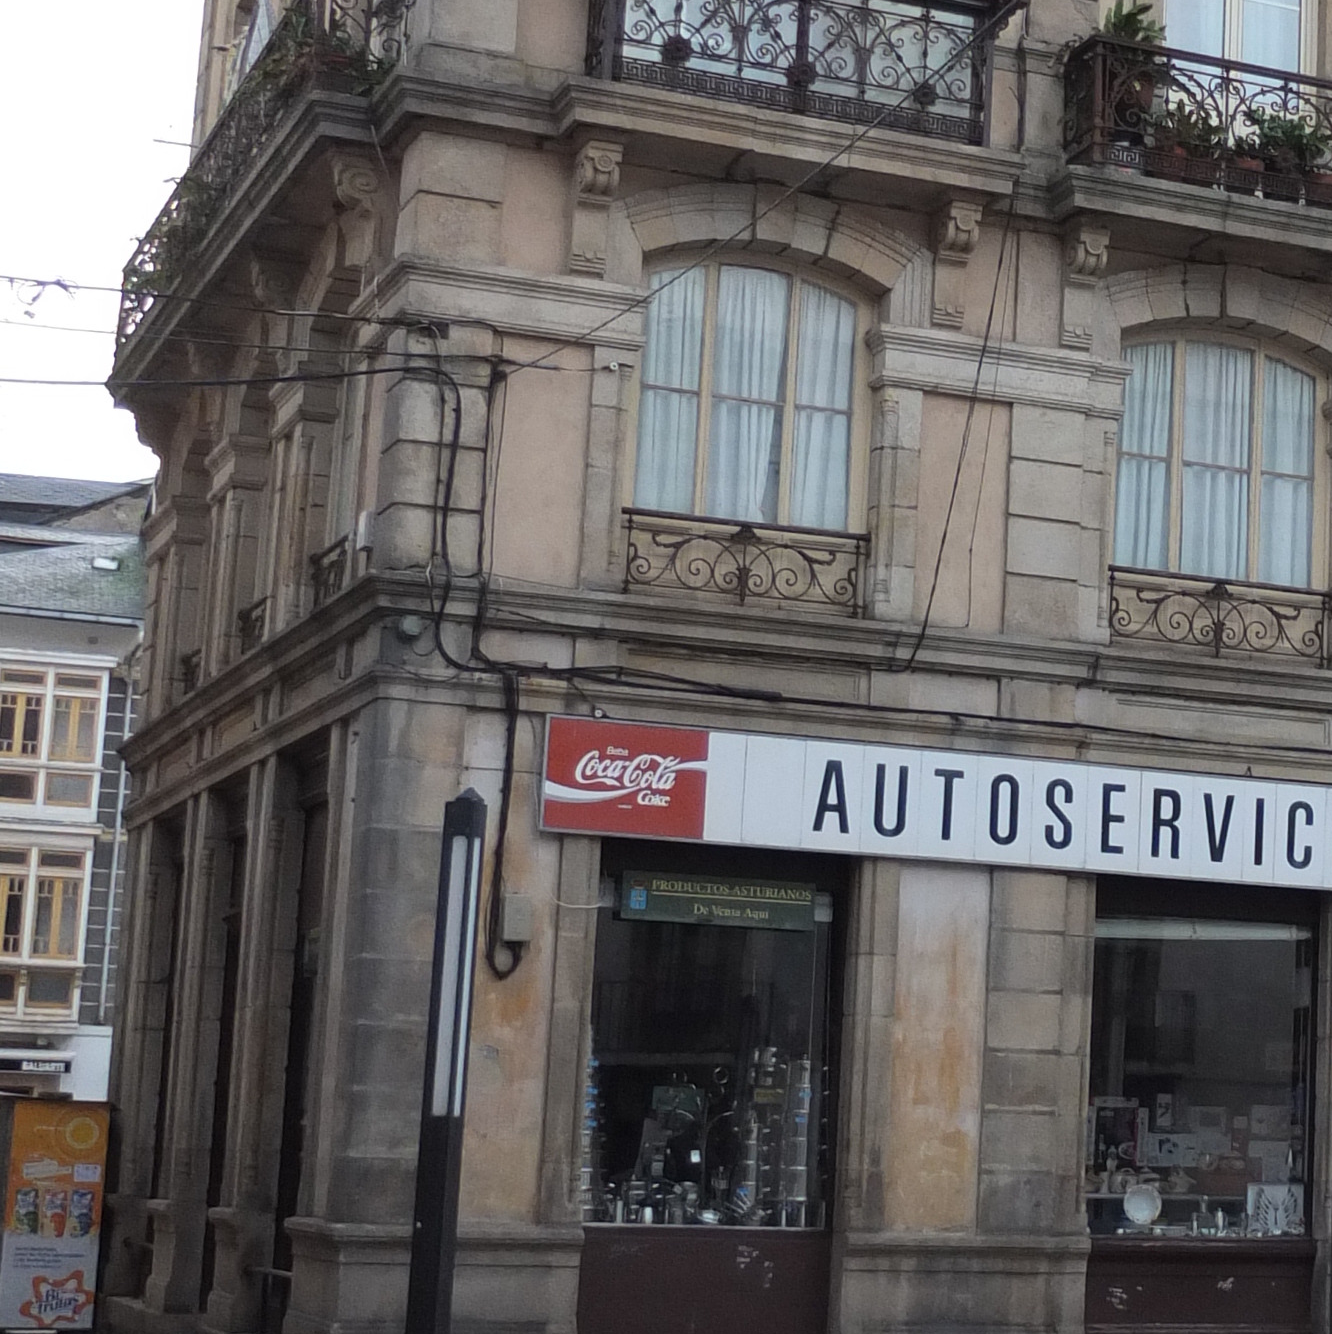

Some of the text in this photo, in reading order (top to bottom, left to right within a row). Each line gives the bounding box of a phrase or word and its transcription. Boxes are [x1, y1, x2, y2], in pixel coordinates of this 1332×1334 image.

[575, 750, 680, 791] Coca-Cola
[637, 790, 671, 807] Coke
[651, 878, 812, 901] PRODUCTOS ASTURIANOS
[693, 903, 709, 915] De
